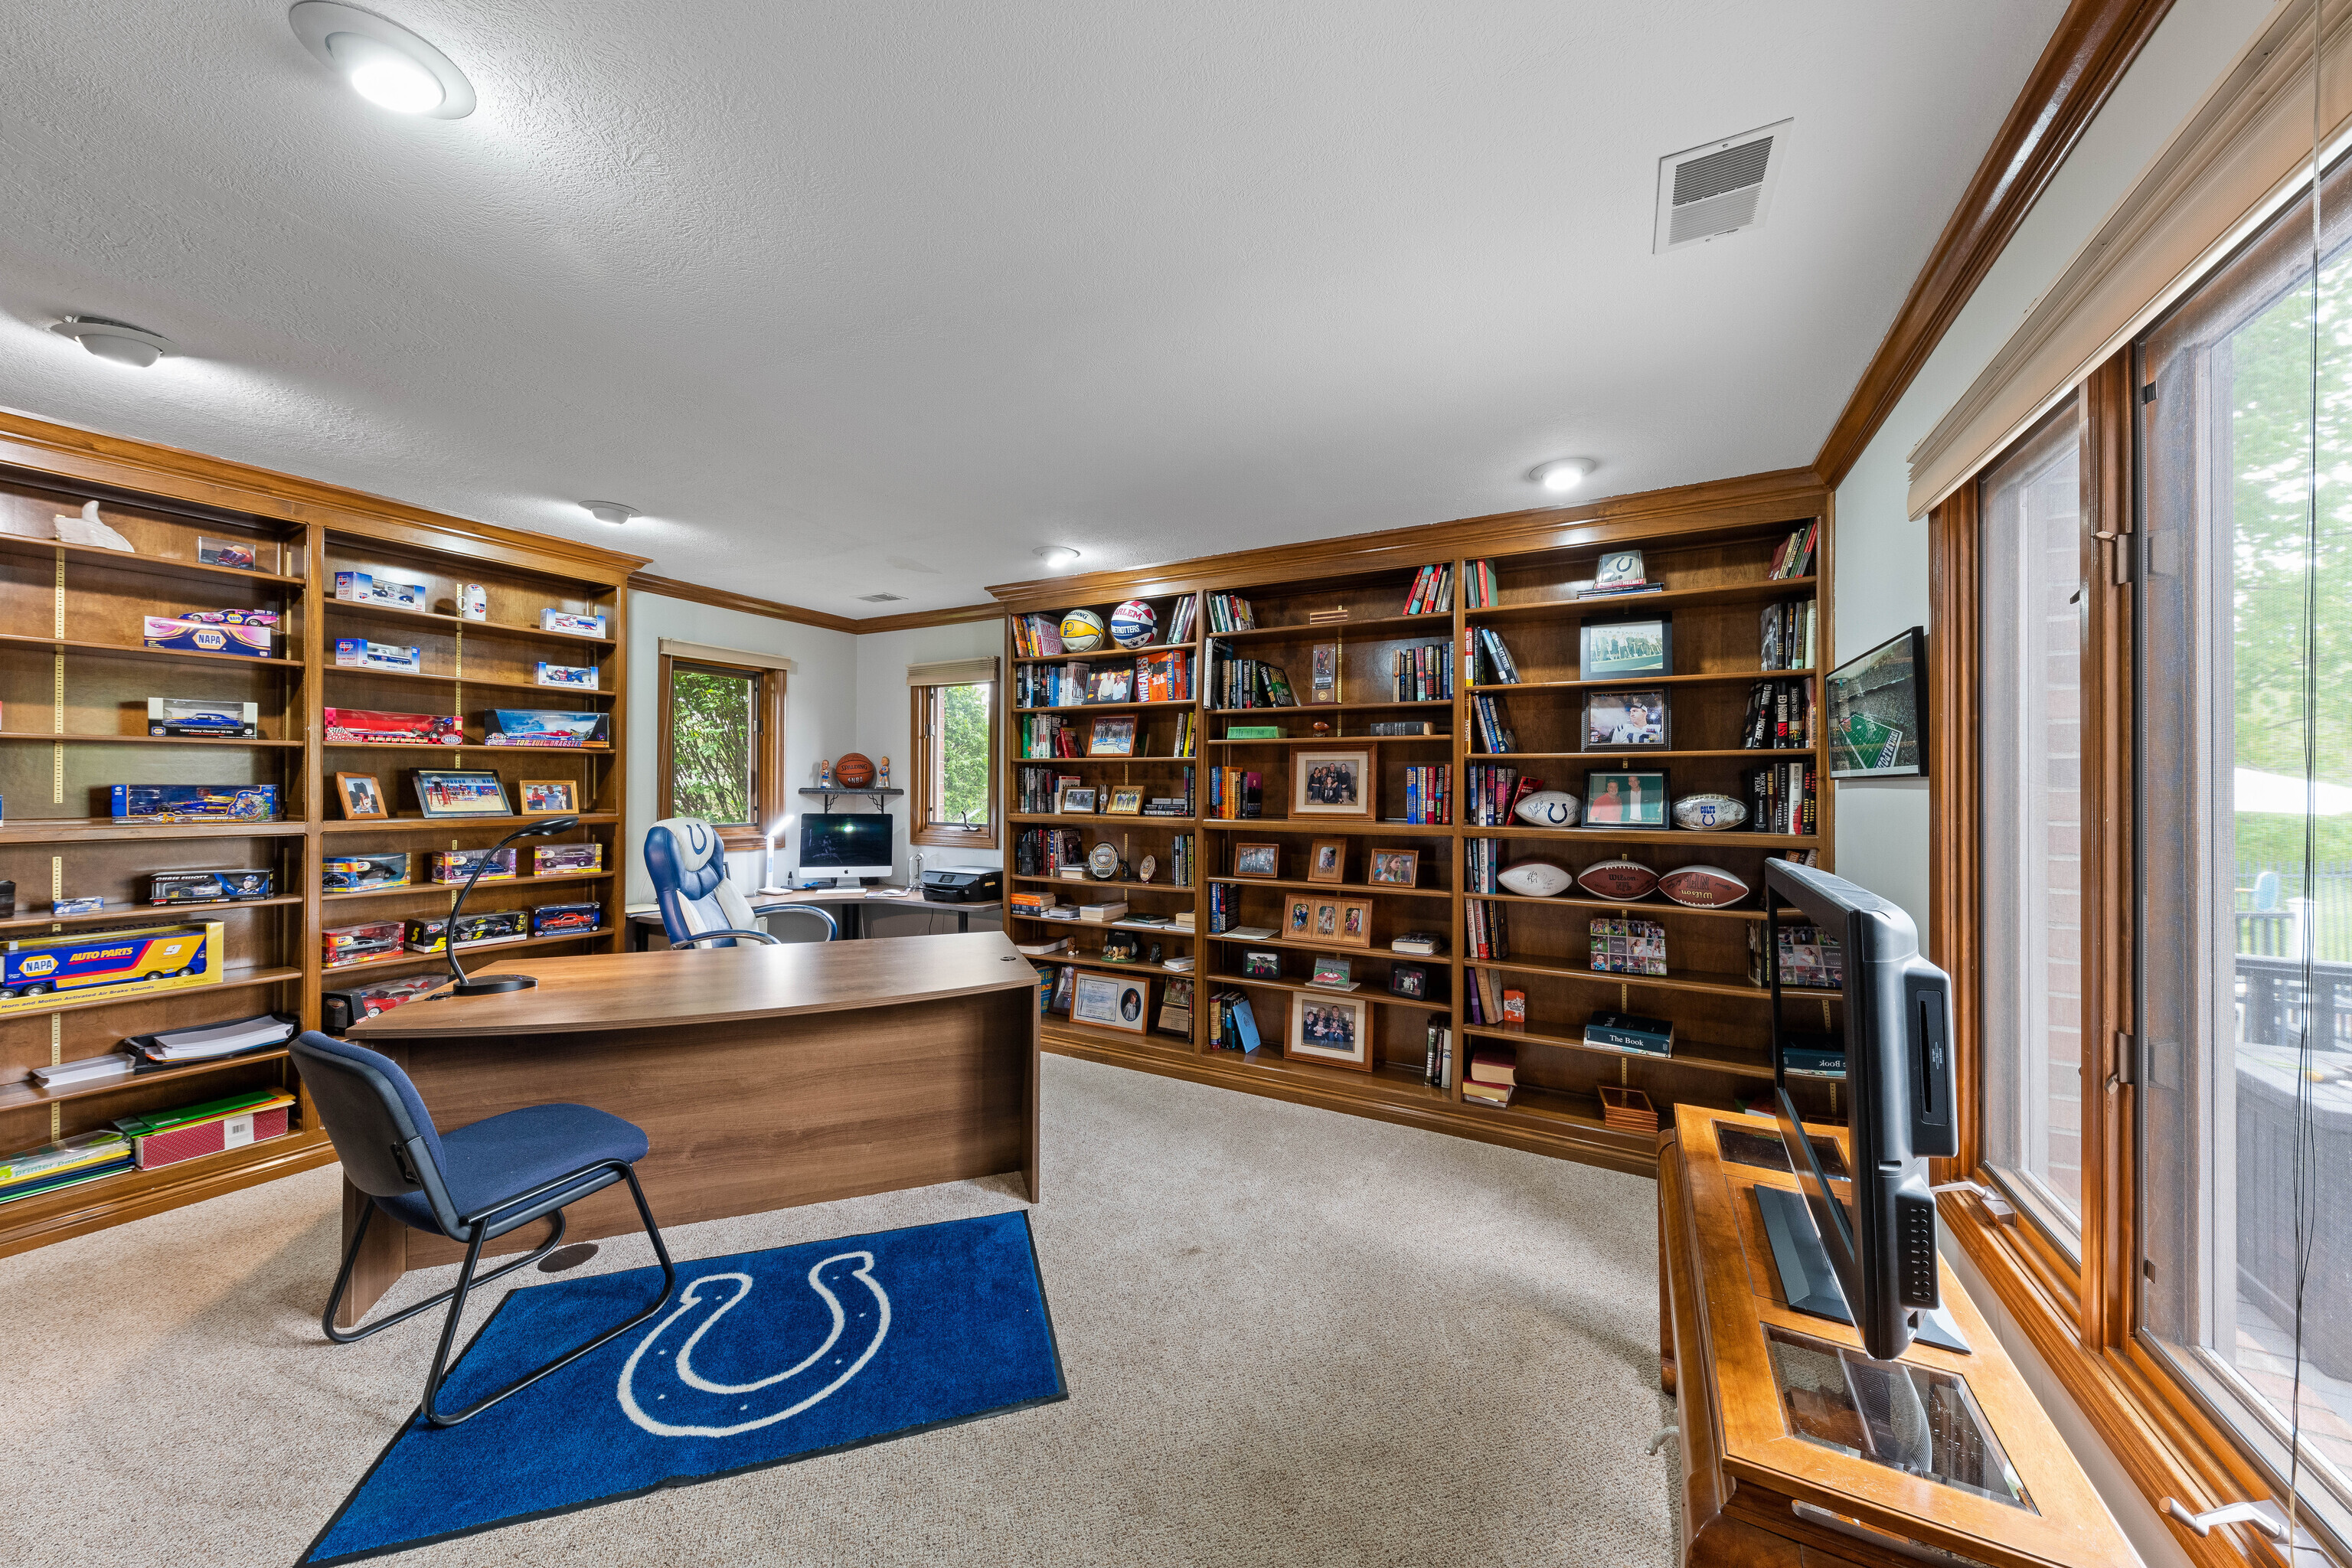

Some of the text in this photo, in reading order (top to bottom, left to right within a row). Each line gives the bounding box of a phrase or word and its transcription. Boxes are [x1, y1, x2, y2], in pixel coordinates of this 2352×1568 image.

[198, 635, 221, 645] NAPA
[1269, 666, 1285, 676] NELSON
[1270, 674, 1286, 684] DEMILLE
[1761, 691, 1771, 704] McBAIN
[1778, 694, 1787, 737] ED McBAIN KISS
[1486, 720, 1496, 743] ROMANCE
[1755, 718, 1766, 740] MISCHIEF
[1700, 805, 1715, 814] COLTS
[1615, 881, 1632, 890] NFL
[1684, 874, 1709, 890] NFL
[1681, 890, 1712, 899] Wilson
[411, 927, 420, 942] 5
[473, 931, 484, 940] 5
[162, 945, 182, 956] 9
[430, 937, 447, 952] 5
[70, 946, 133, 962] AUTO PARTS
[26, 959, 52, 972] NAPA
[64, 992, 96, 1001] Activated
[1625, 1037, 1644, 1046] Book
[15, 1155, 89, 1176] printer paper
